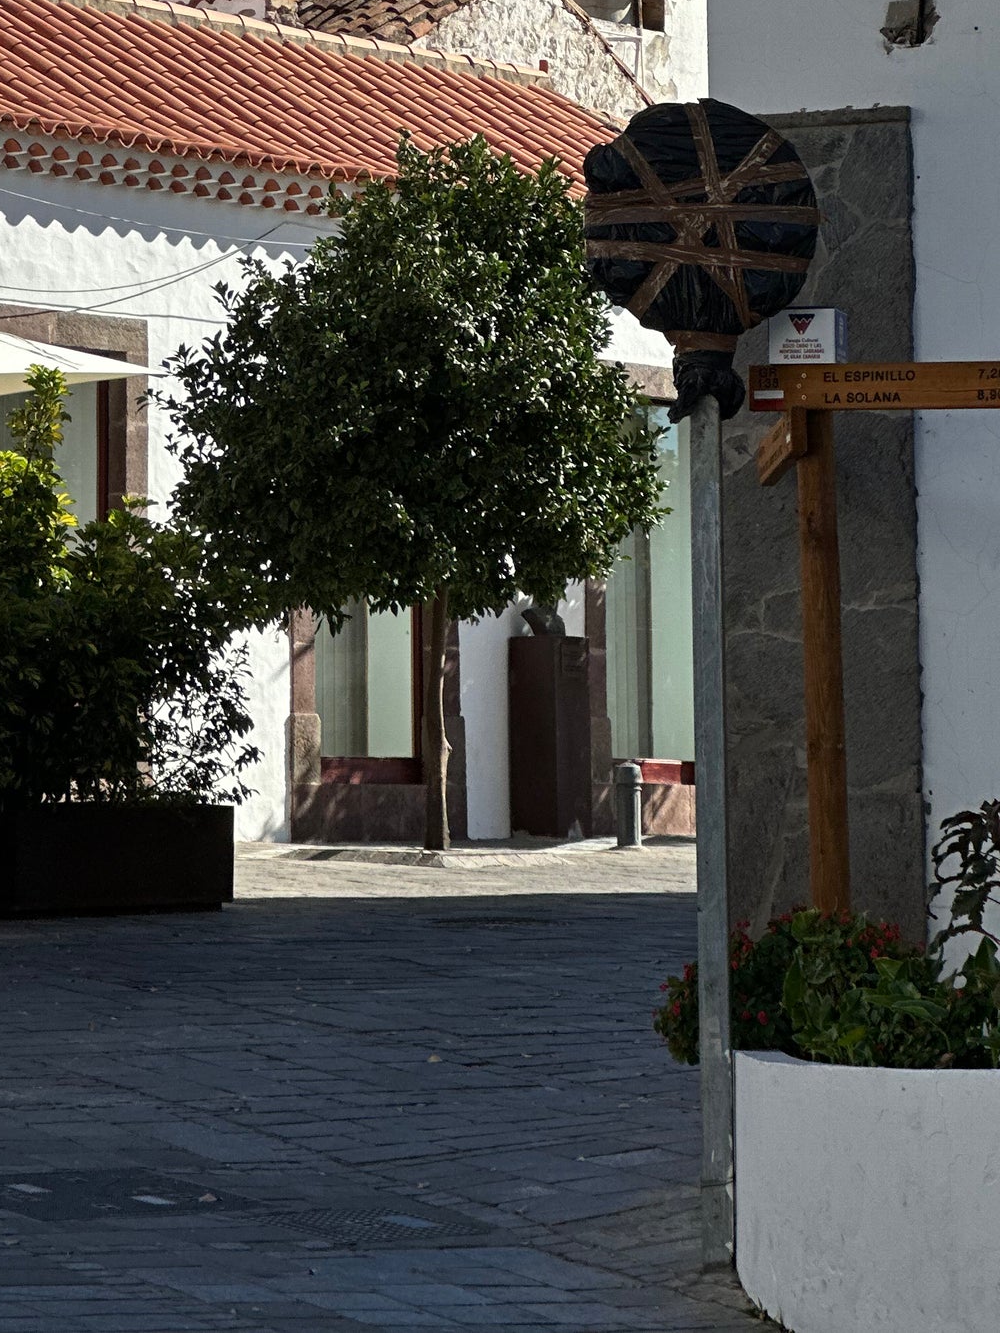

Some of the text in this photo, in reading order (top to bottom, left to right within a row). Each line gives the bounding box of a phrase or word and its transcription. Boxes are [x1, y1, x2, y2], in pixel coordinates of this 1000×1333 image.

[758, 368, 777, 378] GR
[823, 370, 915, 382] EL ESPINILLO
[824, 391, 901, 403] LA SOLANA
